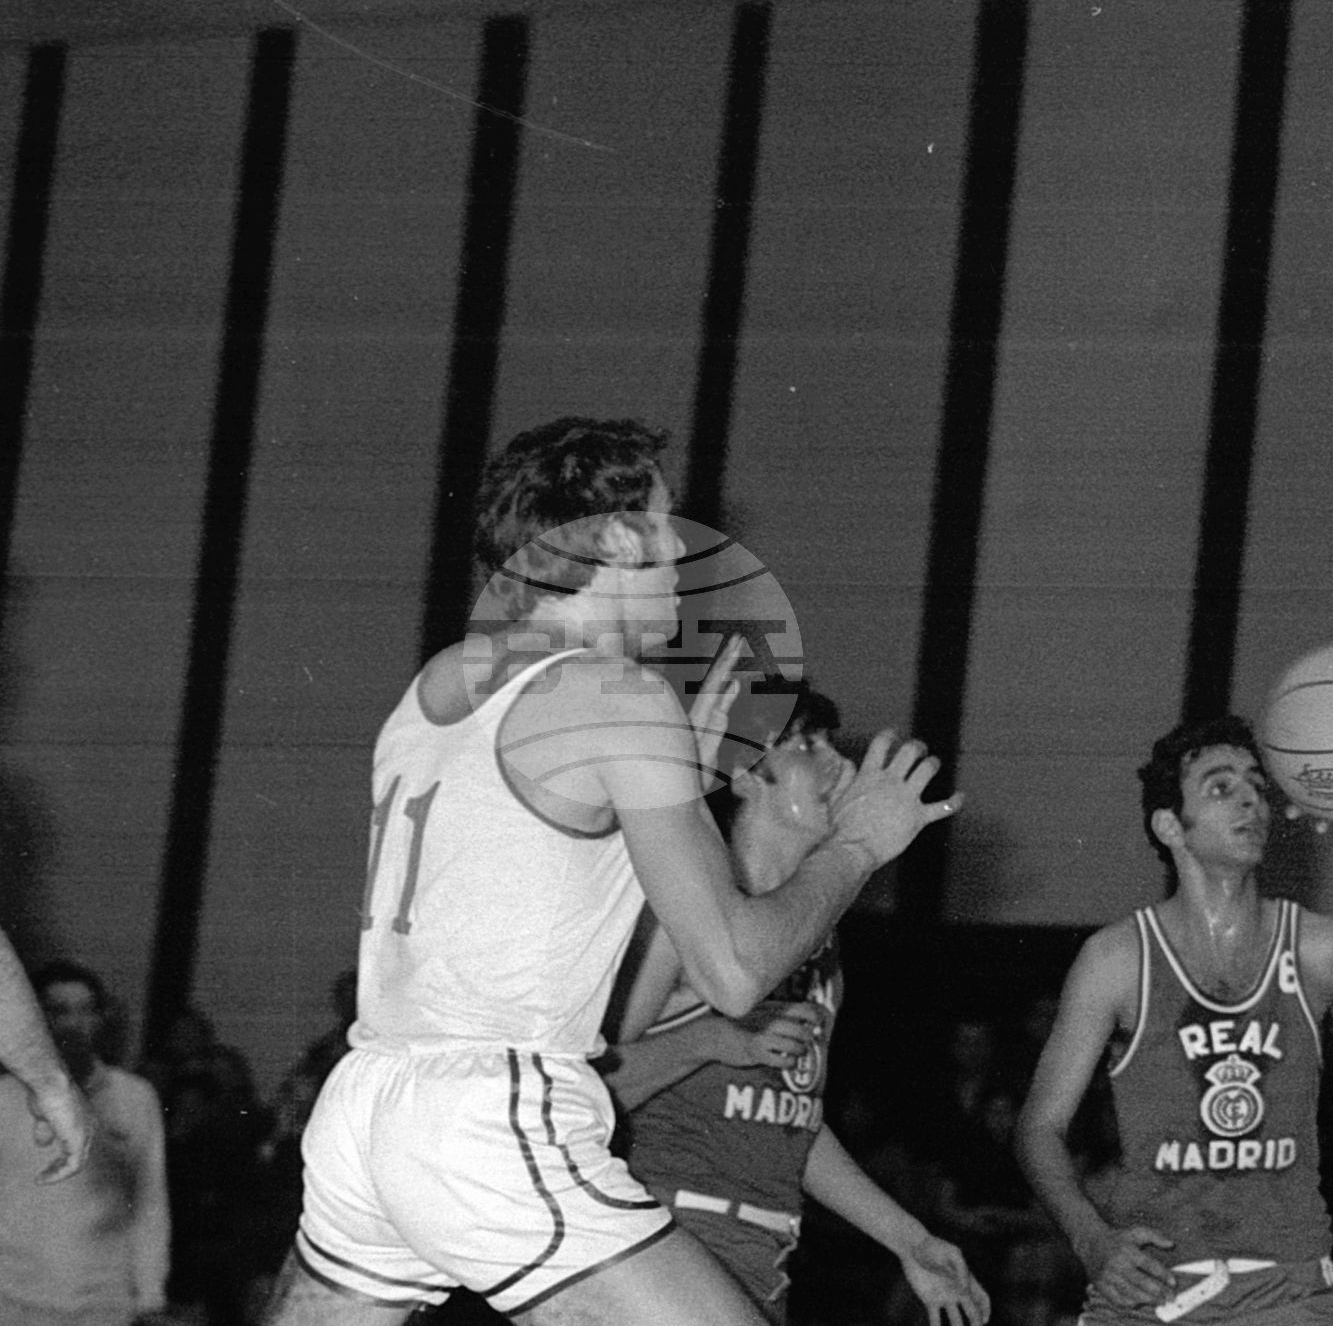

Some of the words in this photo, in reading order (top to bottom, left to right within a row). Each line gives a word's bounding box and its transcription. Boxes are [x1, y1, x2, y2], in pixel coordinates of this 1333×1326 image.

[361, 774, 441, 936] 11
[1178, 1021, 1282, 1060] REAL
[724, 1083, 823, 1133] MADRI
[1155, 1137, 1297, 1171] MADRID
